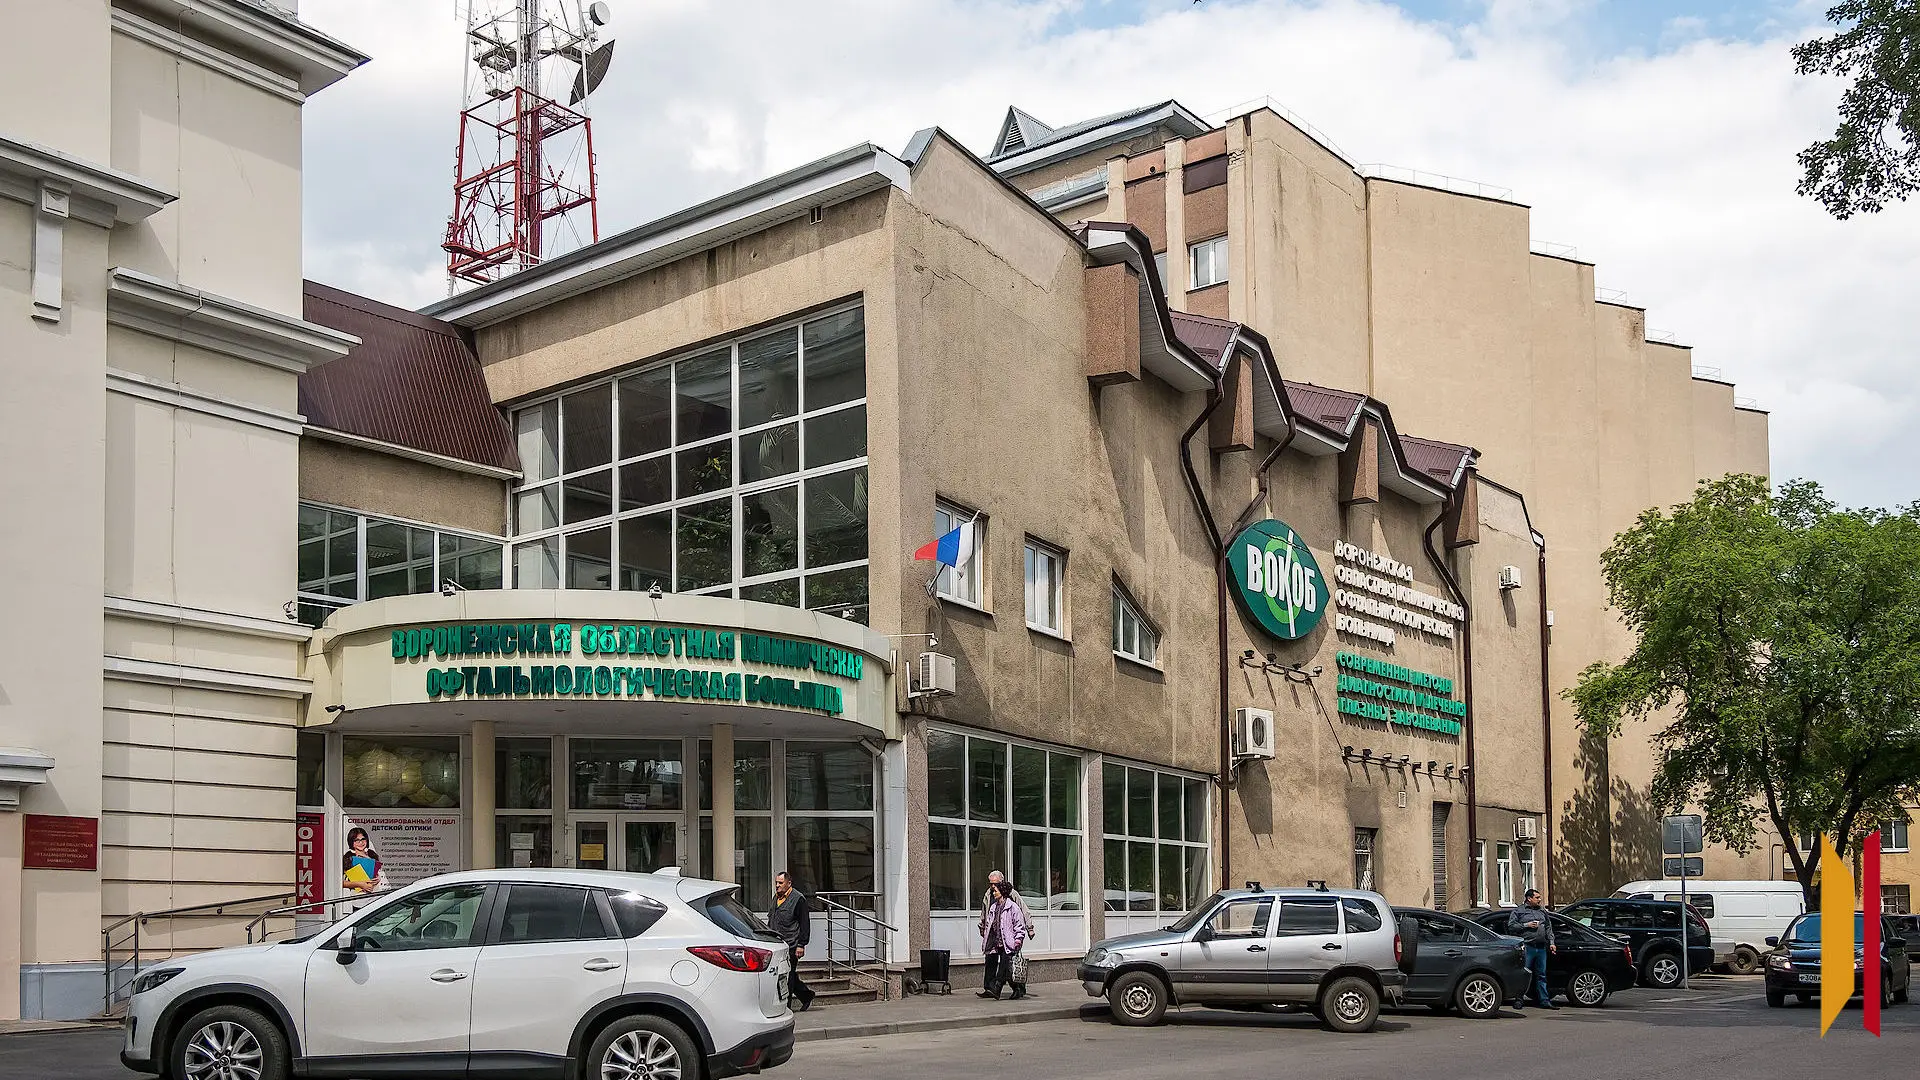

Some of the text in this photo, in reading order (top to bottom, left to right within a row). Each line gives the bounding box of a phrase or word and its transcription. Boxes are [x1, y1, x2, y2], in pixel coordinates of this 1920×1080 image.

[1247, 529, 1317, 637] ВОКОБ
[1334, 539, 1413, 582] ВОРОНЕЖСКАЯ
[391, 623, 863, 681] ВОРОНЕЖСКАЯ ОБЛАСТНАЯ КЛИНИЧЕСКАЯ
[1336, 650, 1413, 684] СОВРЕМЕННЫЕ
[426, 664, 844, 716] ОФТАЛЬМОЛОГИЧЕСКАЯ БОЛЬНИЦА
[1337, 674, 1415, 705] ДИАГНОСТИКИ
[347, 817, 456, 826] СПЕЦИАЛИЗИРОВАННЫЙ ОТДЕЛ
[297, 826, 314, 912] ОПТИКА
